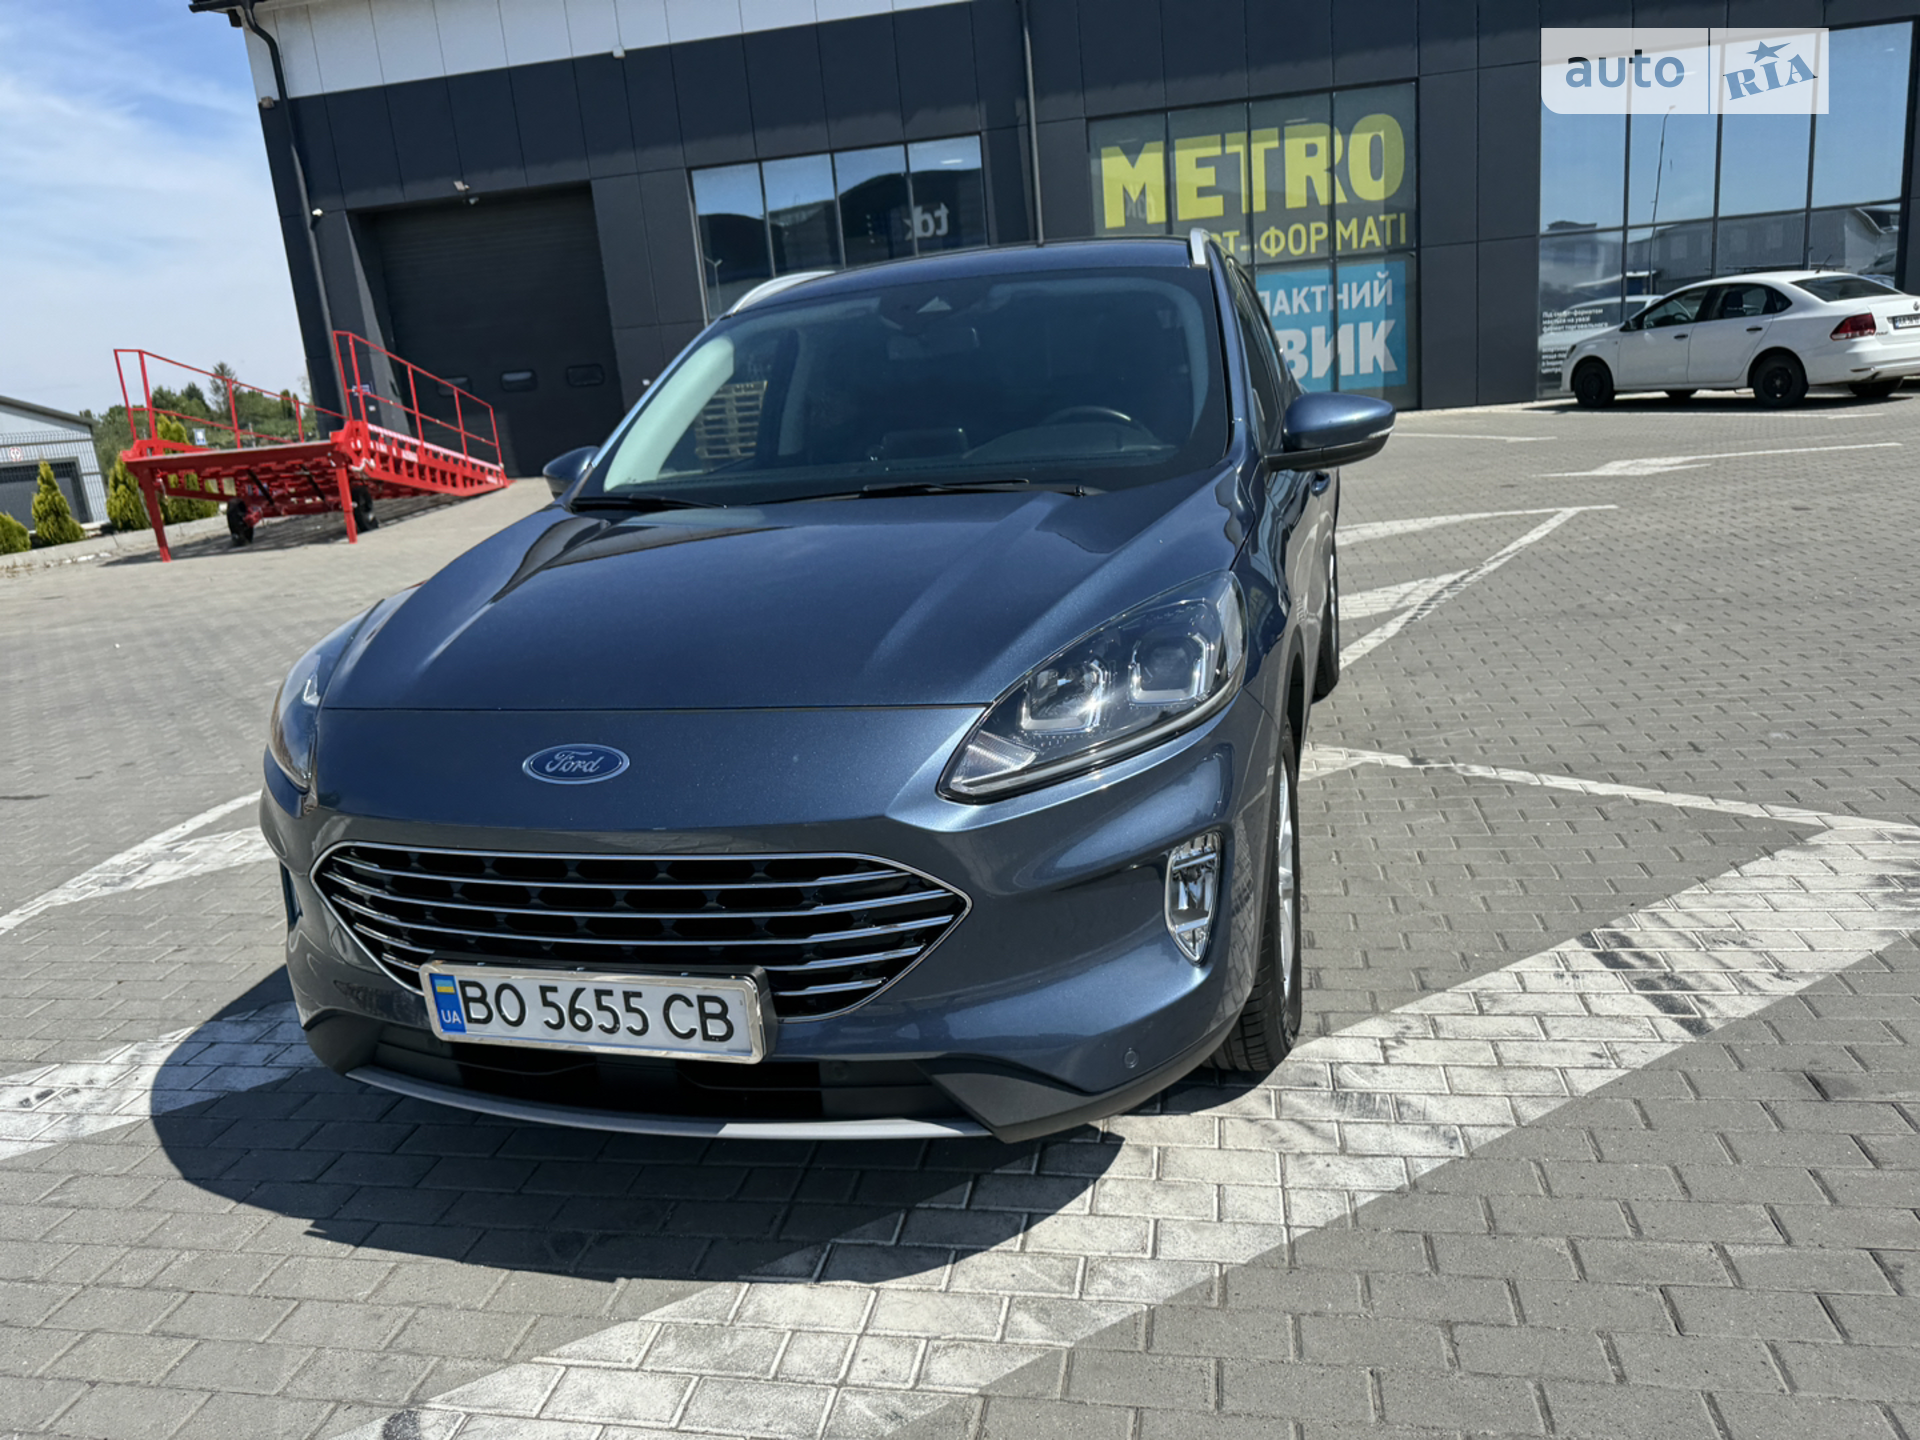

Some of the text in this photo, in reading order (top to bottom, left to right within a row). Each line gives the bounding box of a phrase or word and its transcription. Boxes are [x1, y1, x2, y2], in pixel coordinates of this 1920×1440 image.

[1100, 113, 1405, 229] METRO
[545, 750, 605, 773] Ford
[440, 1008, 463, 1025] UA
[458, 980, 735, 1042] BO 5655 CB
